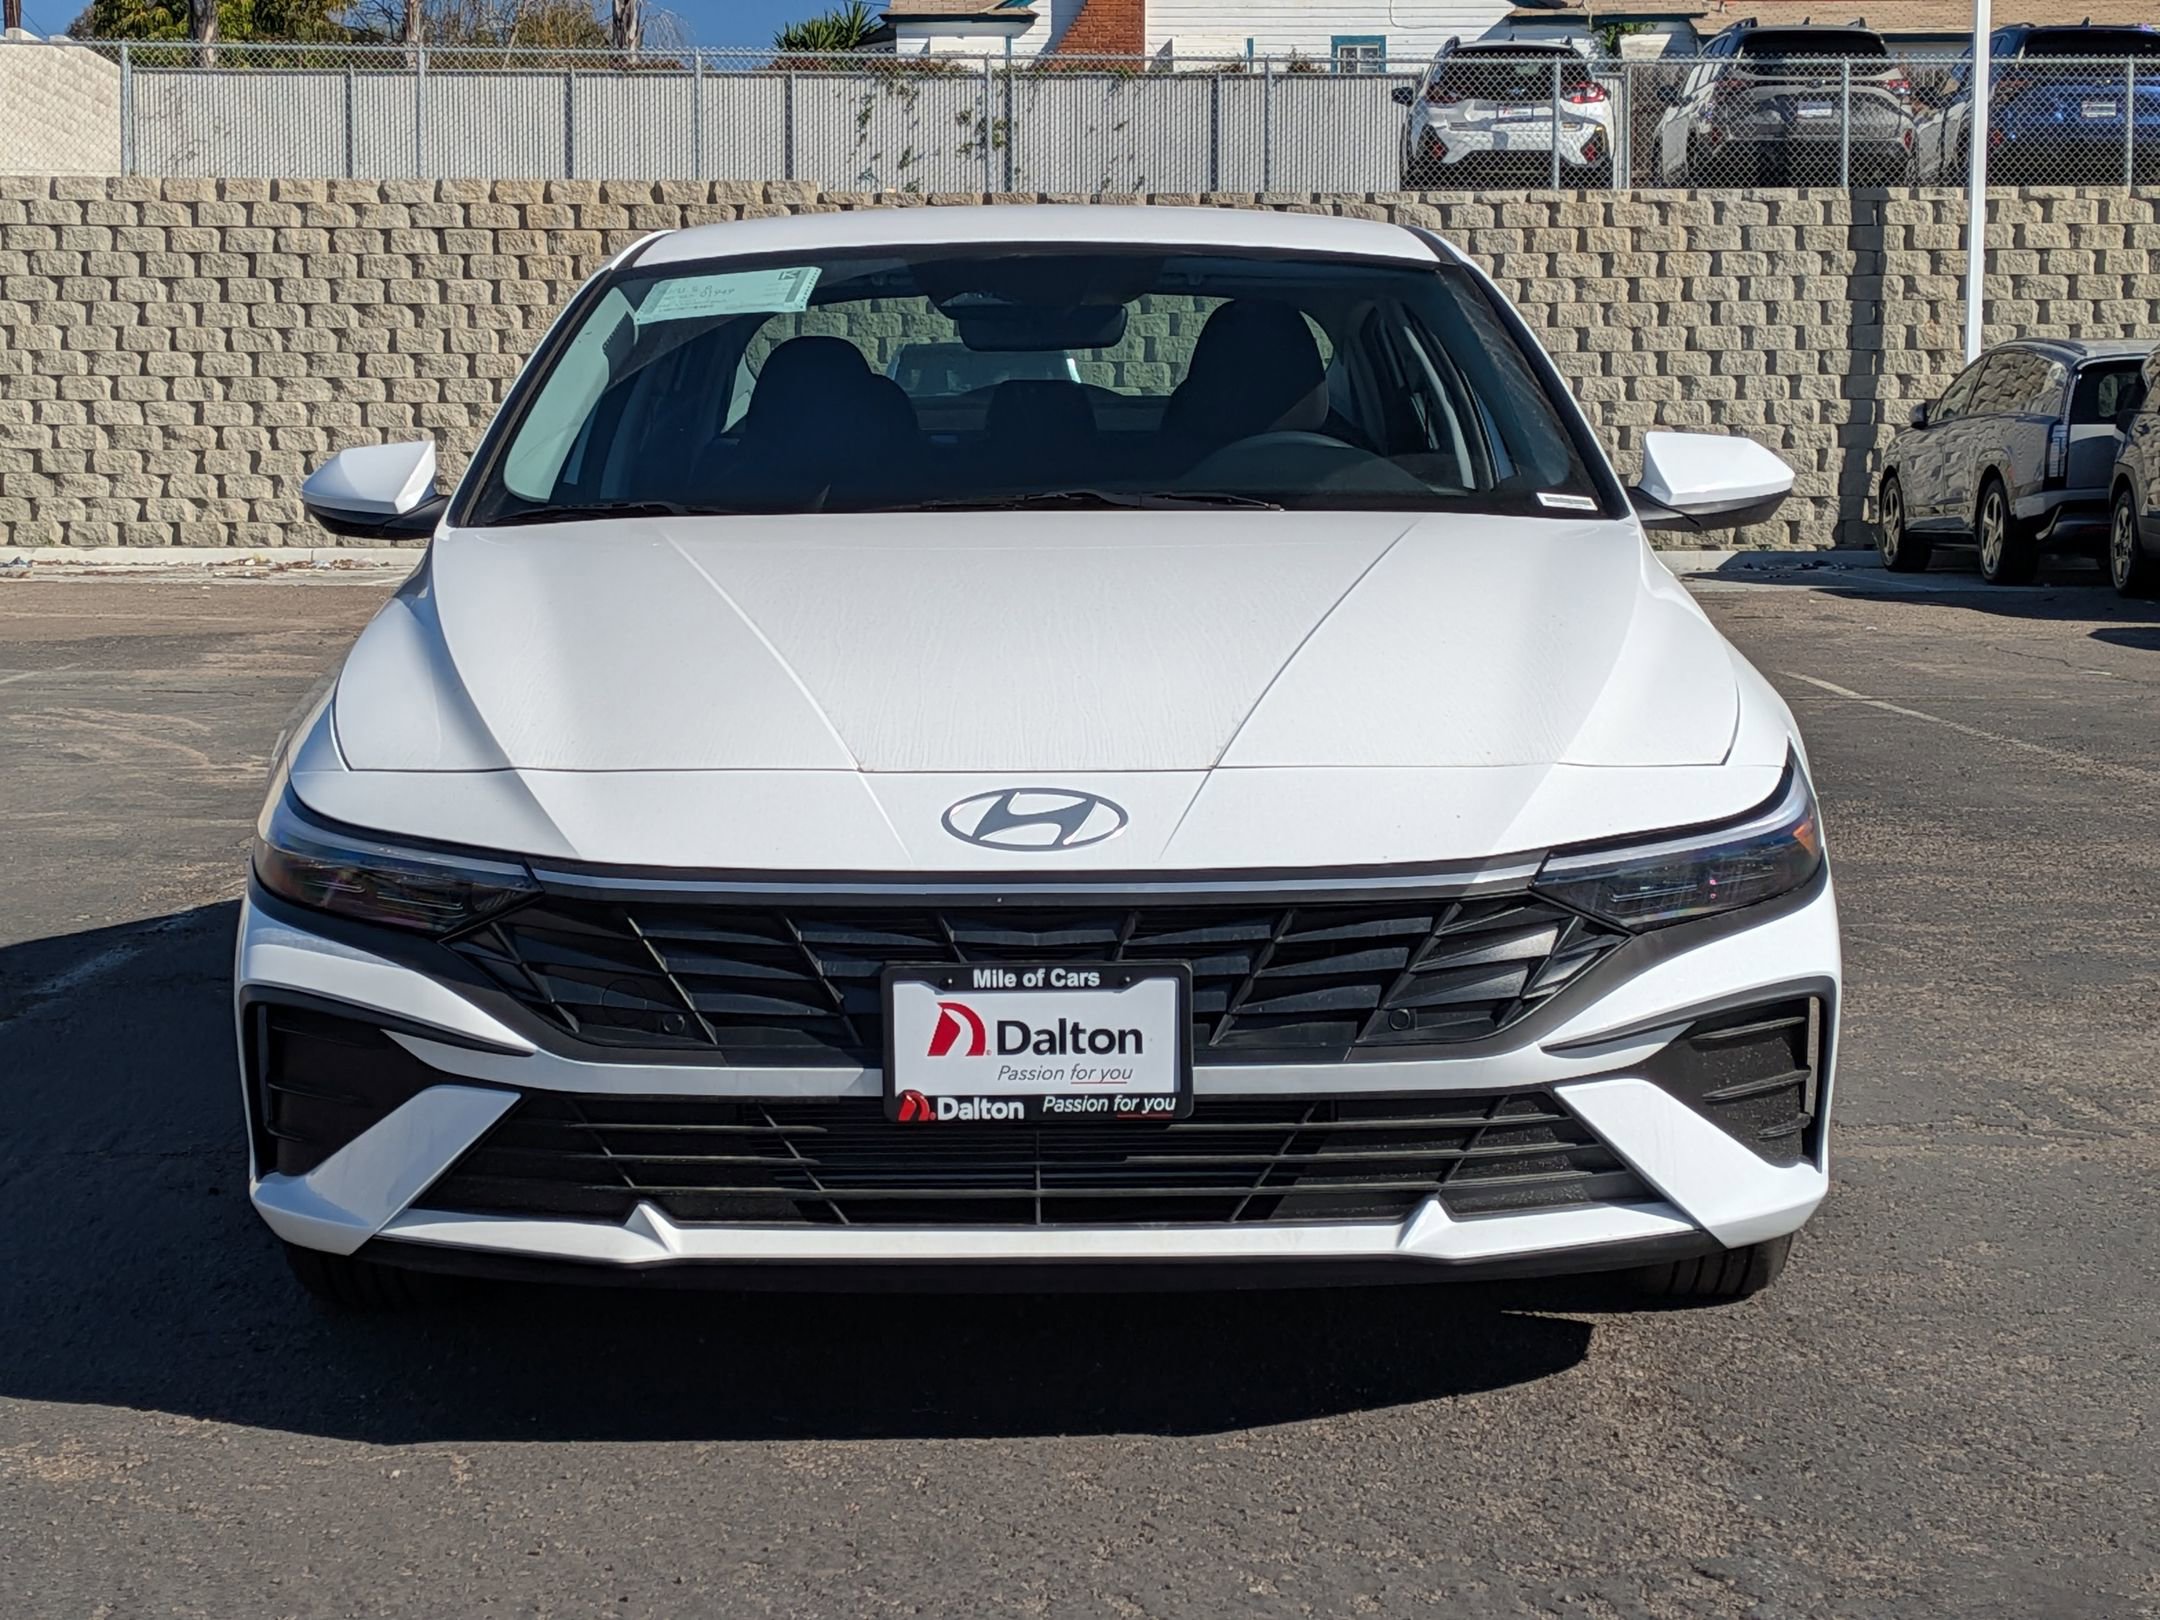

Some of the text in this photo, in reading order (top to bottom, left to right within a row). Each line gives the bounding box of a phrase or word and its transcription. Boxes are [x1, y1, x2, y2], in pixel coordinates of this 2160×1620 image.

[973, 968, 1100, 988] Mile of Cars
[997, 1018, 1142, 1056] Dalton
[997, 1063, 1133, 1083] Passion for you
[938, 1097, 1024, 1121] Dalton
[1043, 1095, 1176, 1115] Passion for you
